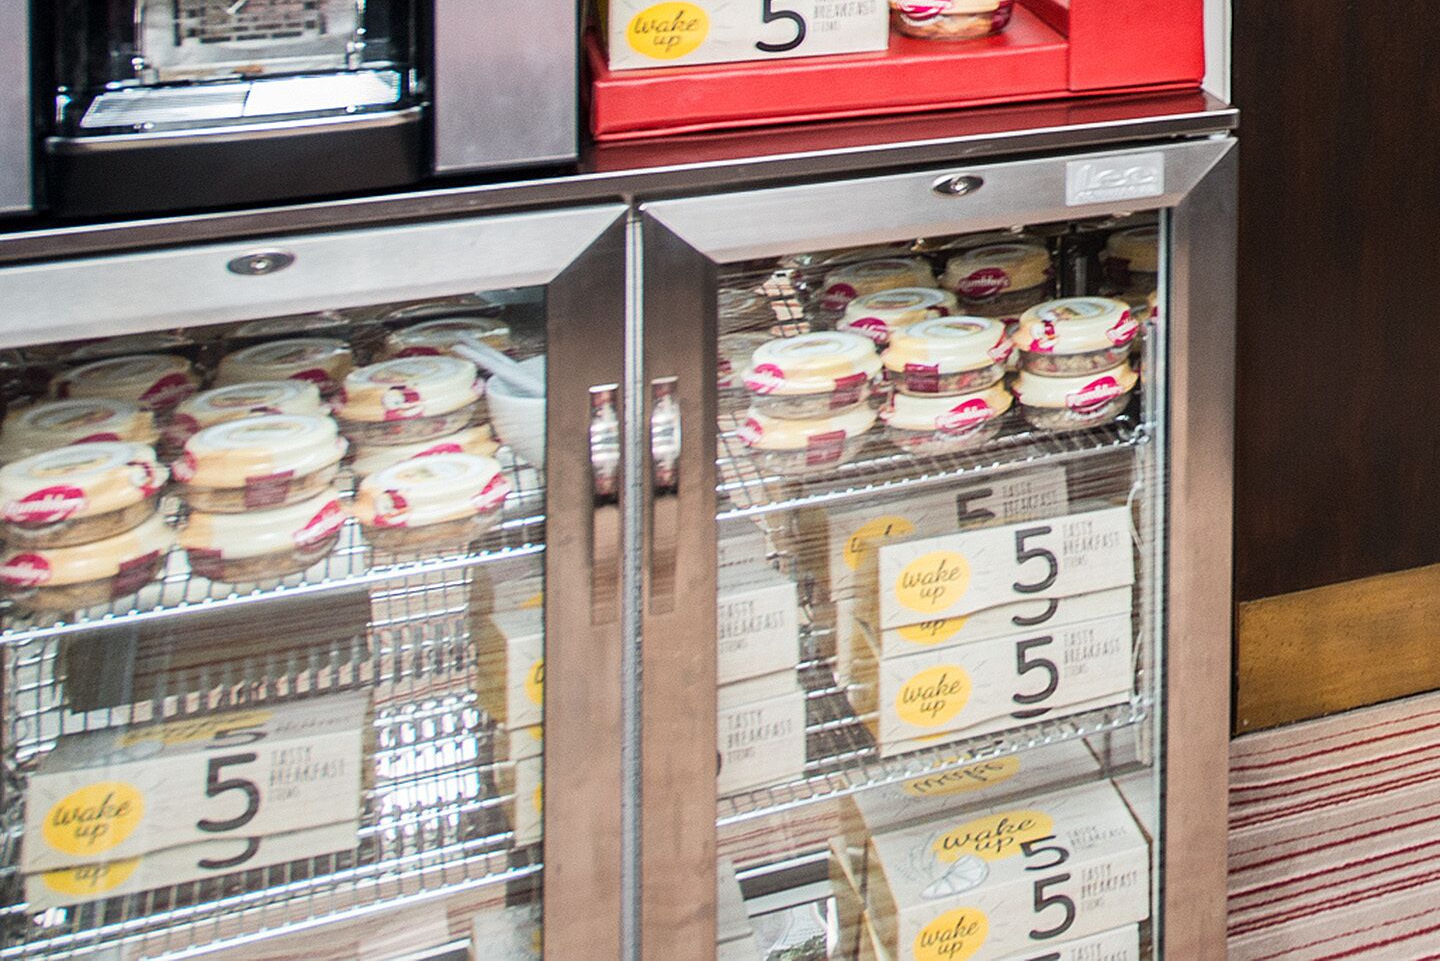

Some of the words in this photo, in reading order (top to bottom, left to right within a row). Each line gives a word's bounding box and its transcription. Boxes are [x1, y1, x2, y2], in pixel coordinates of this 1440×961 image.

[634, 9, 698, 34] wake
[652, 33, 682, 53] up
[1061, 530, 1121, 555] BREAKFAST
[901, 558, 961, 589] wake
[1012, 525, 1059, 594] 5
[919, 586, 946, 606] up
[1062, 637, 1122, 665] BREAKFAST
[1012, 635, 1059, 705] 5
[902, 672, 962, 705] wake
[919, 699, 946, 719] up
[726, 718, 793, 750] BREAKFAST
[269, 757, 346, 787] BREAKFAST
[196, 751, 261, 833] 5
[52, 791, 131, 828] wake
[74, 823, 108, 846] up
[943, 817, 1037, 852] wake
[975, 838, 1015, 854] up
[1019, 834, 1071, 872] 5
[1080, 870, 1138, 900] BREAKFAST
[1028, 872, 1076, 941] 5
[920, 915, 979, 949] wake
[937, 940, 964, 960] up
